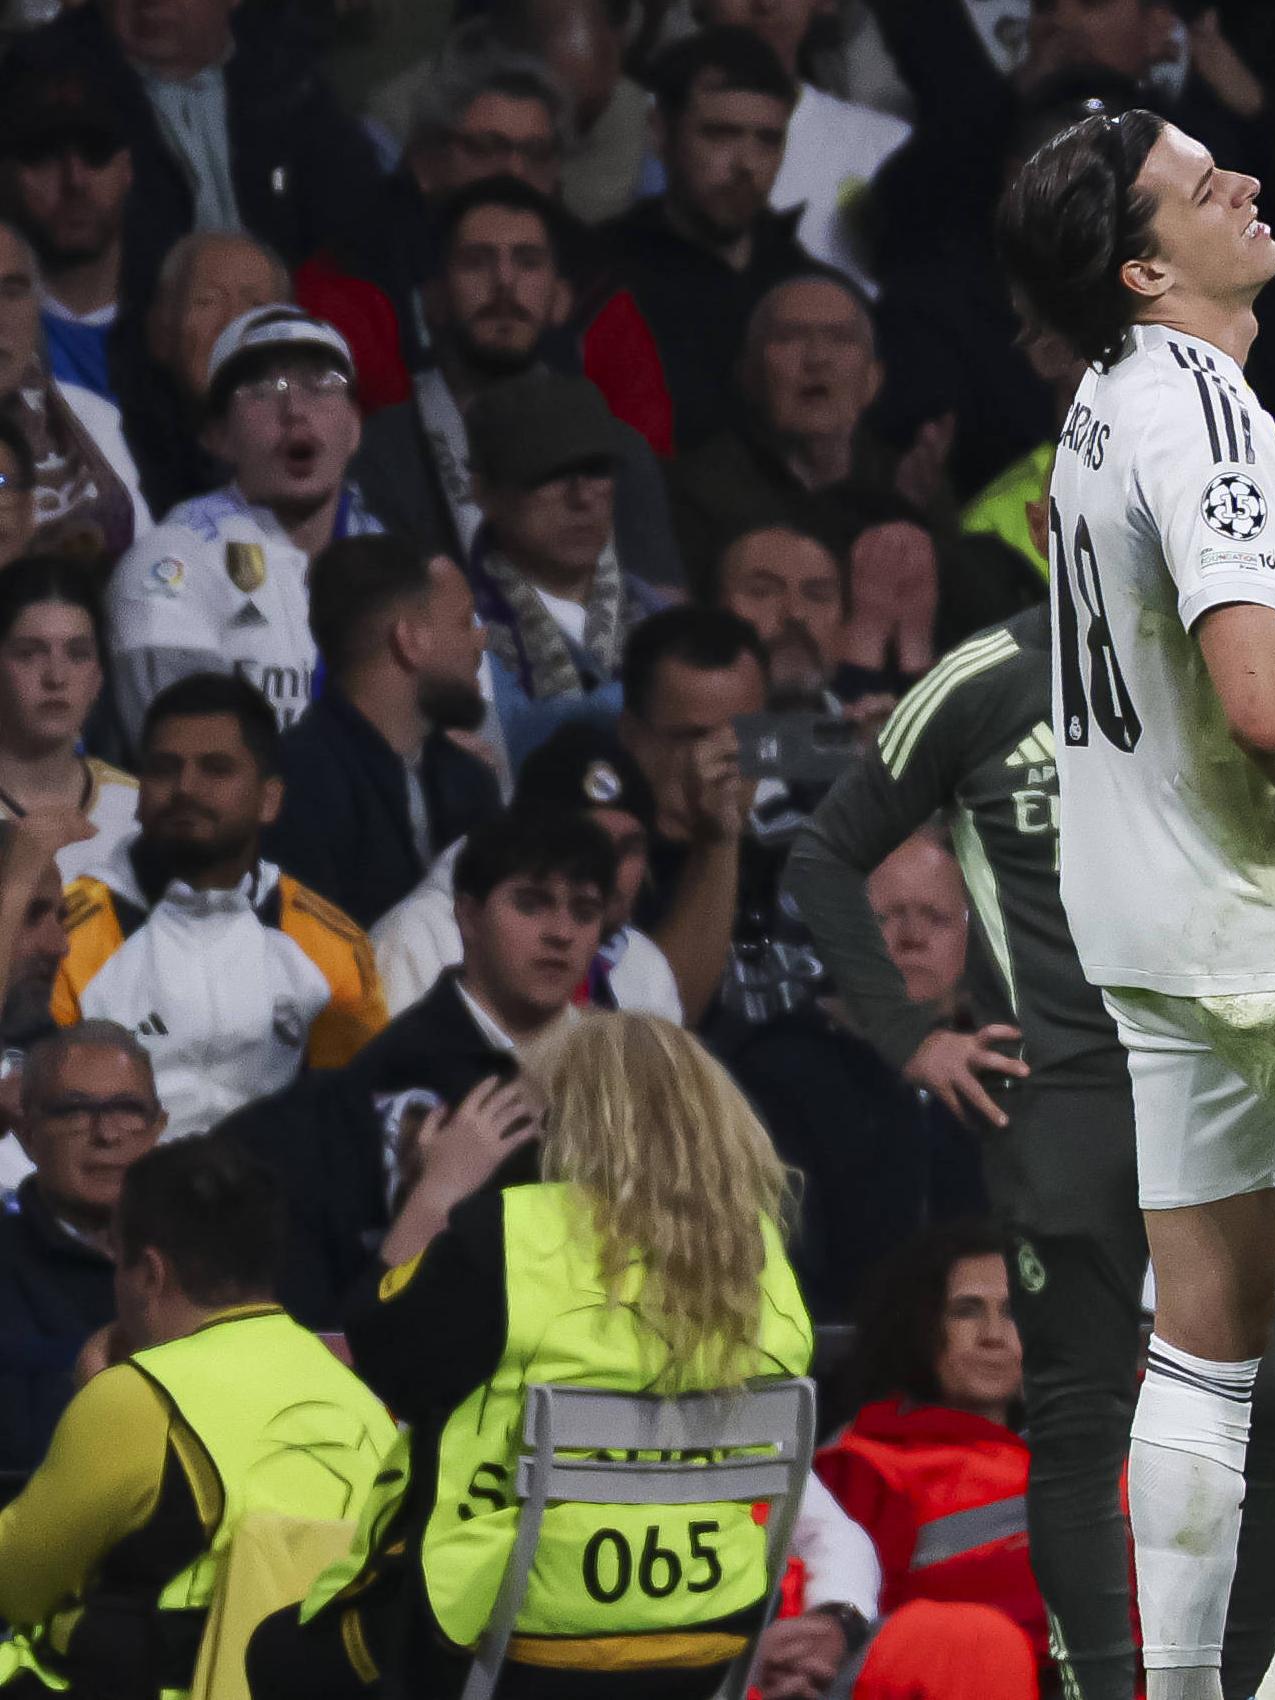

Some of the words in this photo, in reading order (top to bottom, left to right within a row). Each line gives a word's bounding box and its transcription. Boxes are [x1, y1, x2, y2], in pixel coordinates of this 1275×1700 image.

[1220, 493, 1251, 520] 15
[1050, 496, 1143, 754] 18
[583, 1520, 723, 1603] 065
